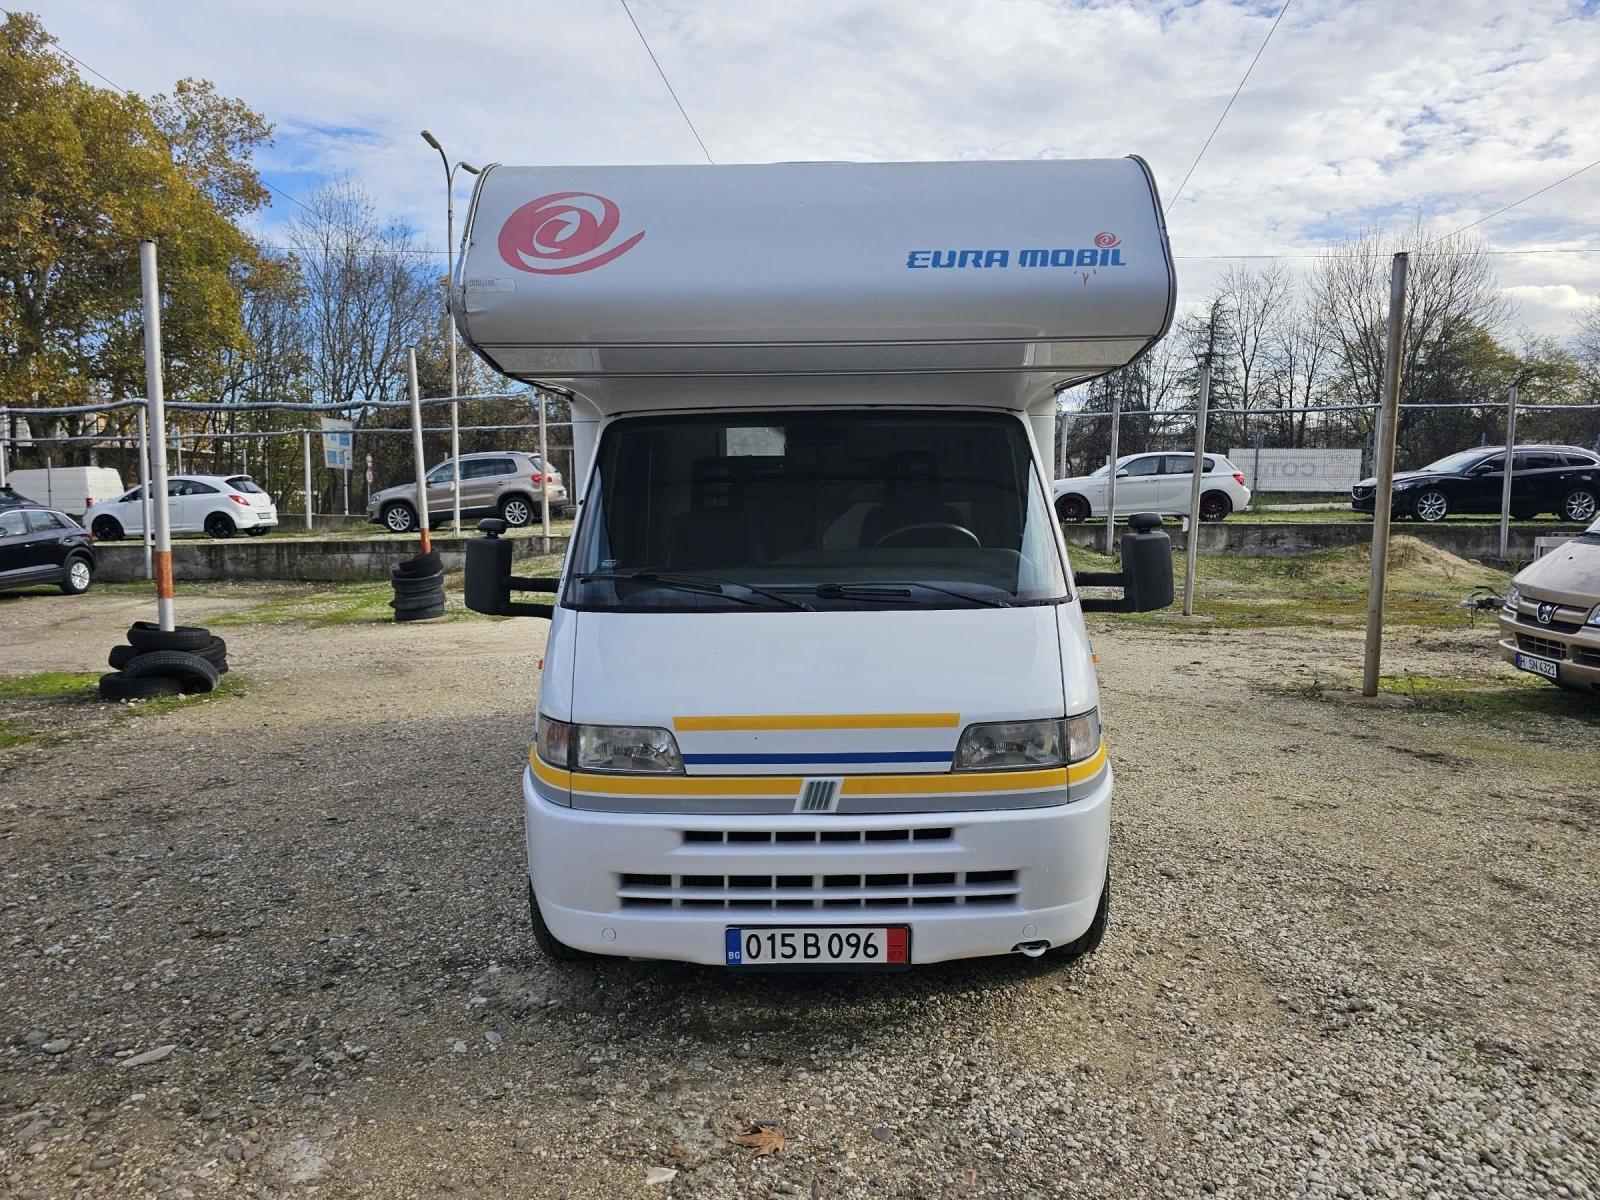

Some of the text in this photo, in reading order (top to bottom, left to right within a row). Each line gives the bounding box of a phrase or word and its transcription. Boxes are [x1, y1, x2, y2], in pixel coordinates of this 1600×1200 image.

[907, 248, 1126, 268] EURA MOBIL
[728, 951, 740, 960] BG
